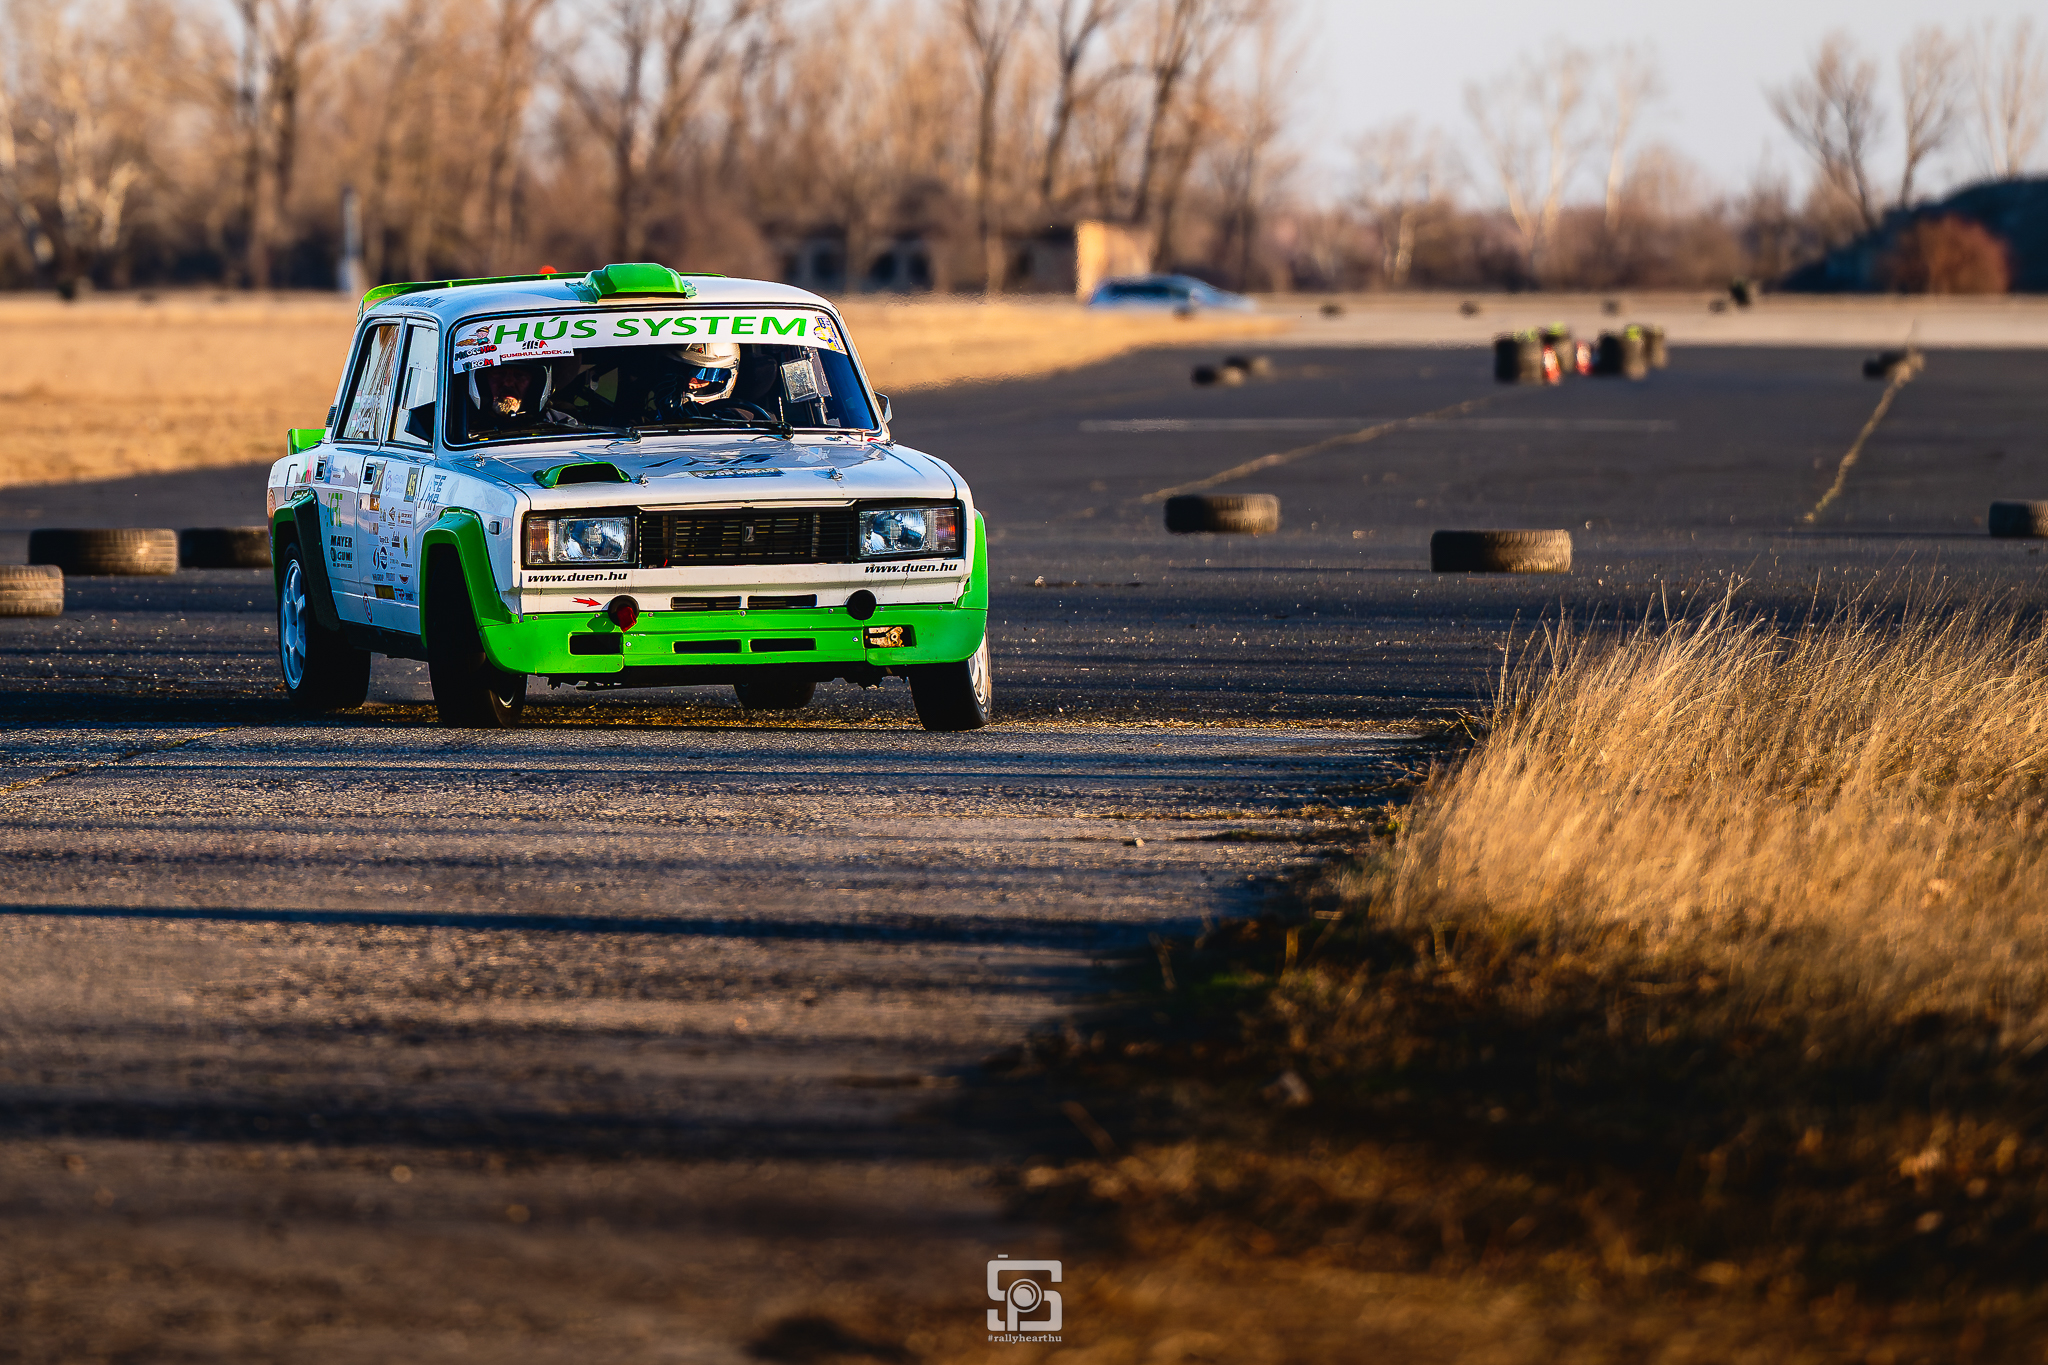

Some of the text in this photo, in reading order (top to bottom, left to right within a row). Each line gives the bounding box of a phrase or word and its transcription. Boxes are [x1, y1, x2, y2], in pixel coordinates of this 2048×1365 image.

[493, 317, 598, 344] HÚS
[613, 316, 807, 338] SYSTEM
[330, 535, 353, 548] MAYER
[337, 551, 353, 561] GUMI
[864, 562, 958, 574] www.duen.hu
[527, 571, 628, 583] www.duen.hu
